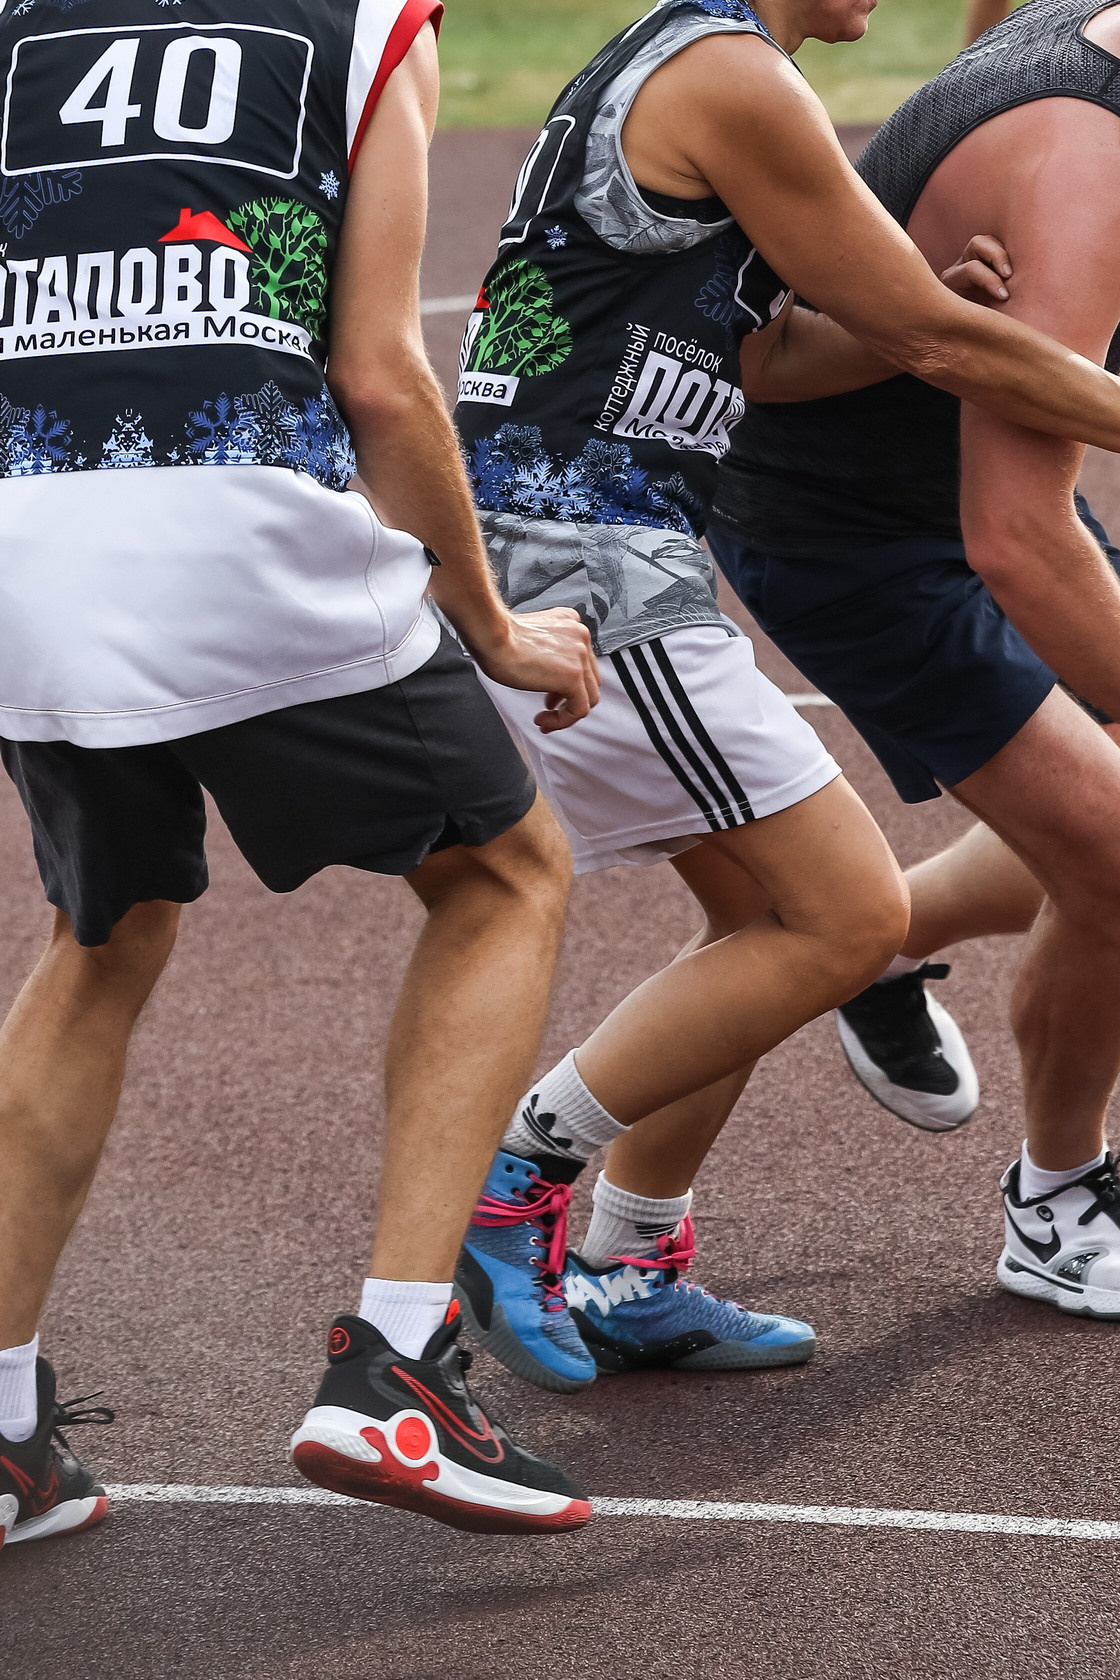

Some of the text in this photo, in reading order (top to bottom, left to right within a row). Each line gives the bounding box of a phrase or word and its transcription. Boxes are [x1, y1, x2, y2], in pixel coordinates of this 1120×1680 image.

[59, 36, 242, 147] 40
[0, 244, 251, 328] ТАПОВО
[15, 322, 190, 352] маленькая
[593, 322, 651, 432] коттеджный
[653, 331, 724, 374] посёлок
